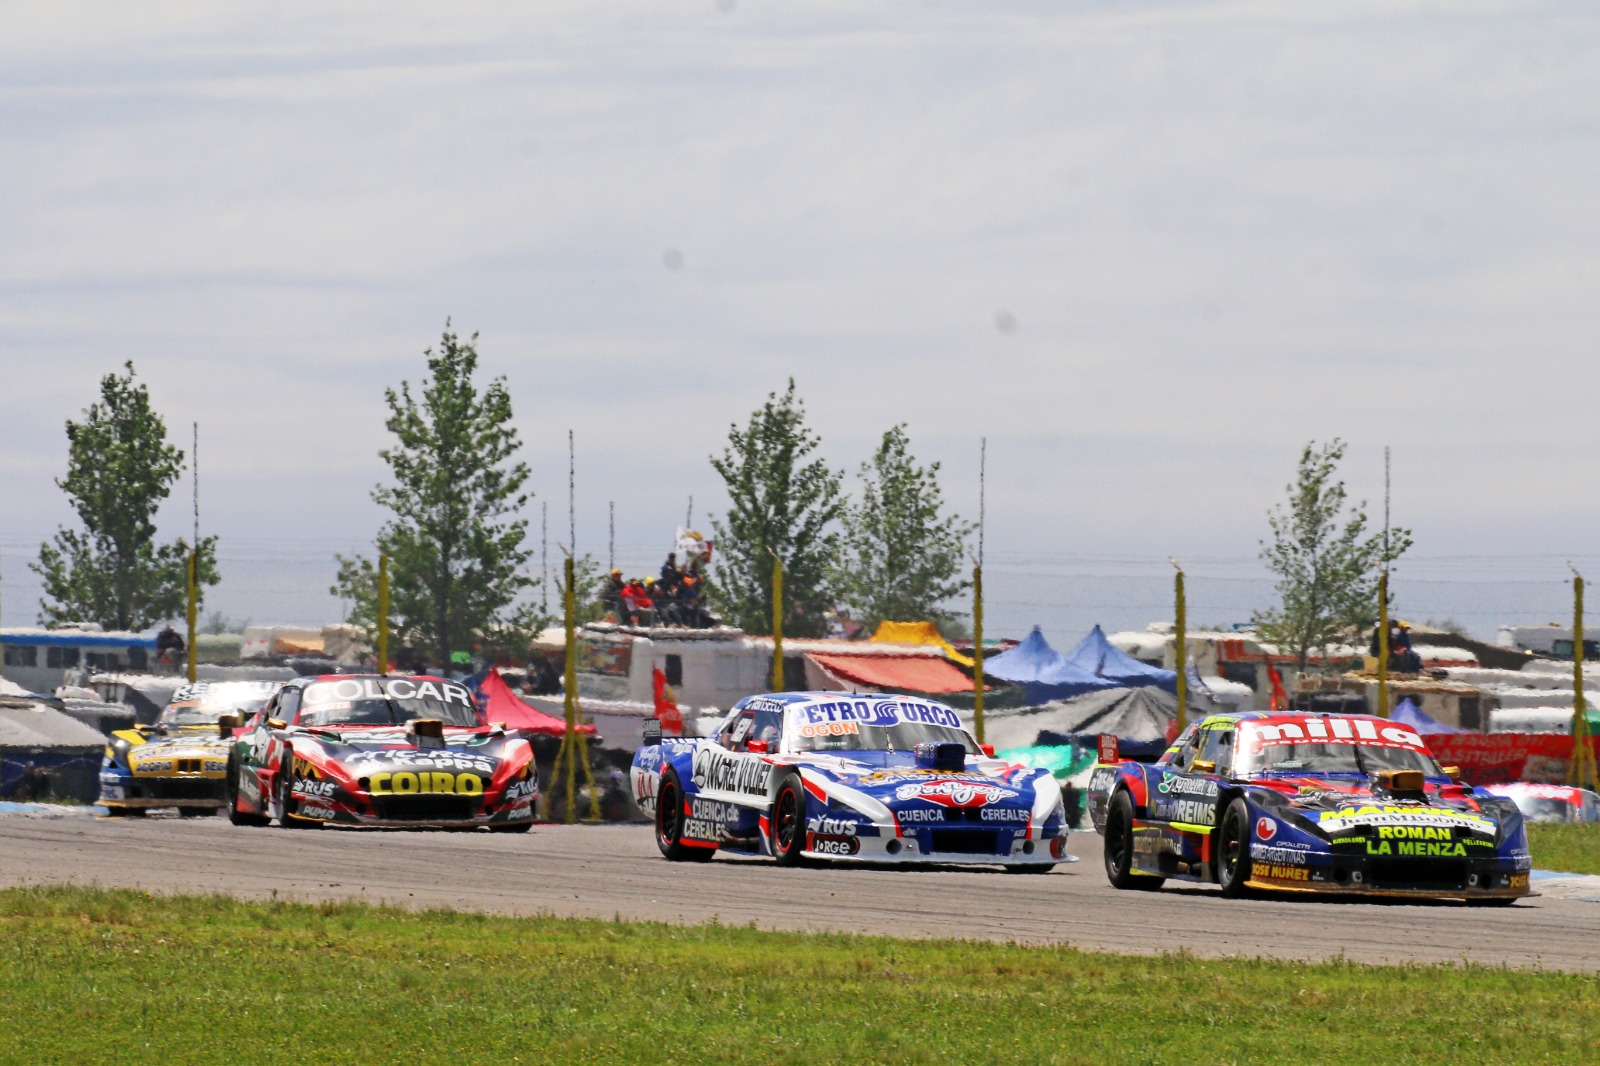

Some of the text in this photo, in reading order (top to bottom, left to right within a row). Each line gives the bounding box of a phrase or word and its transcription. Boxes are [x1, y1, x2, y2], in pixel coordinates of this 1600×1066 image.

[302, 679, 471, 708] COLCAR
[391, 757, 493, 774] Kappa
[369, 772, 483, 796] COIRO
[303, 805, 336, 820] PUMA
[692, 799, 726, 822] CUENCA
[897, 808, 1030, 822] CUENCA CEREALES
[1378, 826, 1452, 840] ROMAN
[1366, 840, 1468, 856] LA MENZA
[1252, 863, 1270, 877] JOSE
